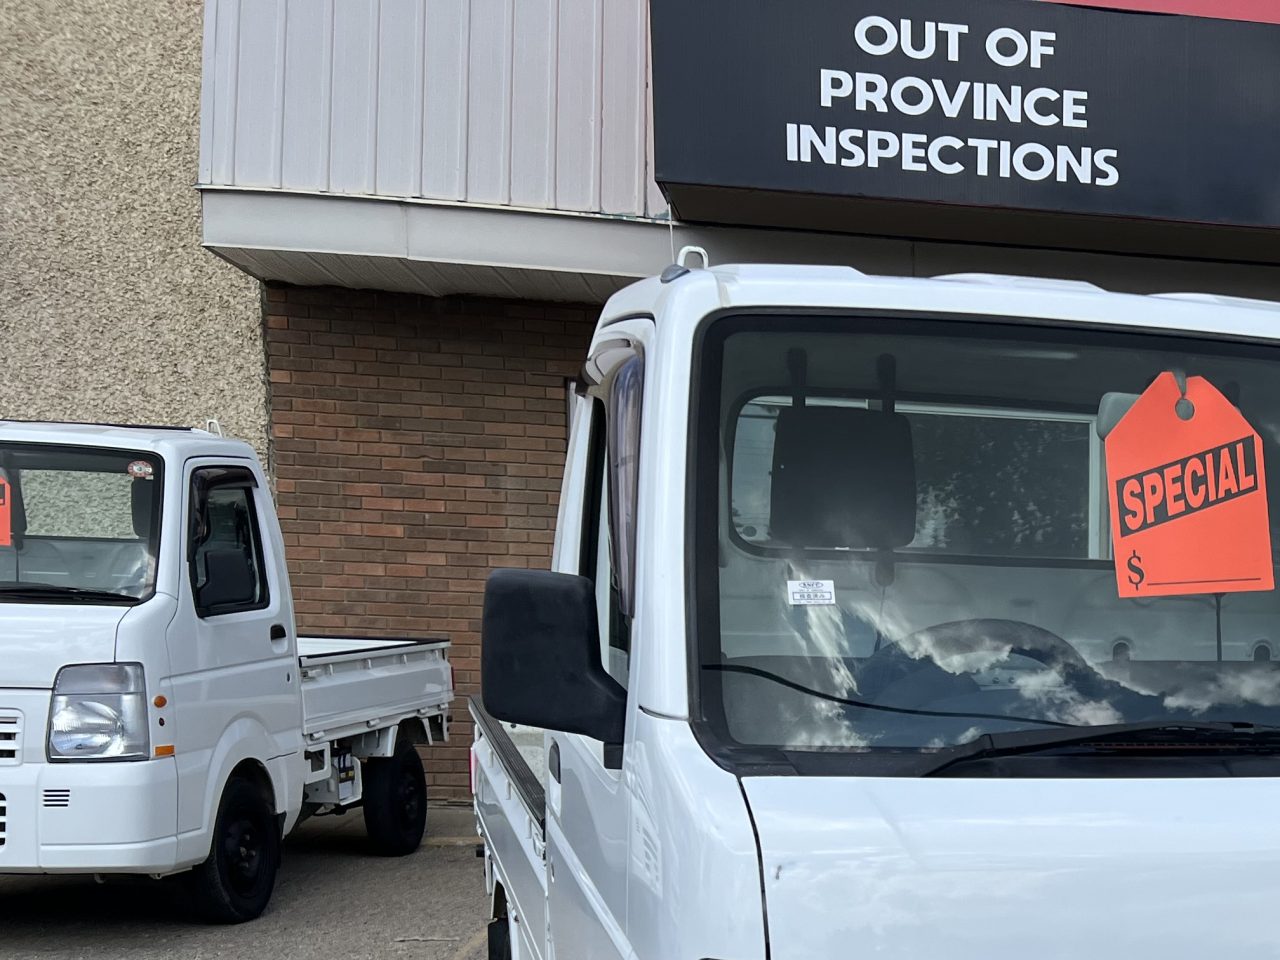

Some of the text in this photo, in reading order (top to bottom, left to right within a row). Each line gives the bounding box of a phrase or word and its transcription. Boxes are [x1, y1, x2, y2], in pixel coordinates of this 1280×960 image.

[854, 15, 1057, 69] OUT OF
[820, 68, 1088, 129] PROVINCE
[786, 122, 1120, 187] INSPECTIONS
[1122, 441, 1255, 531] SPECIAL
[1127, 550, 1145, 591] $
